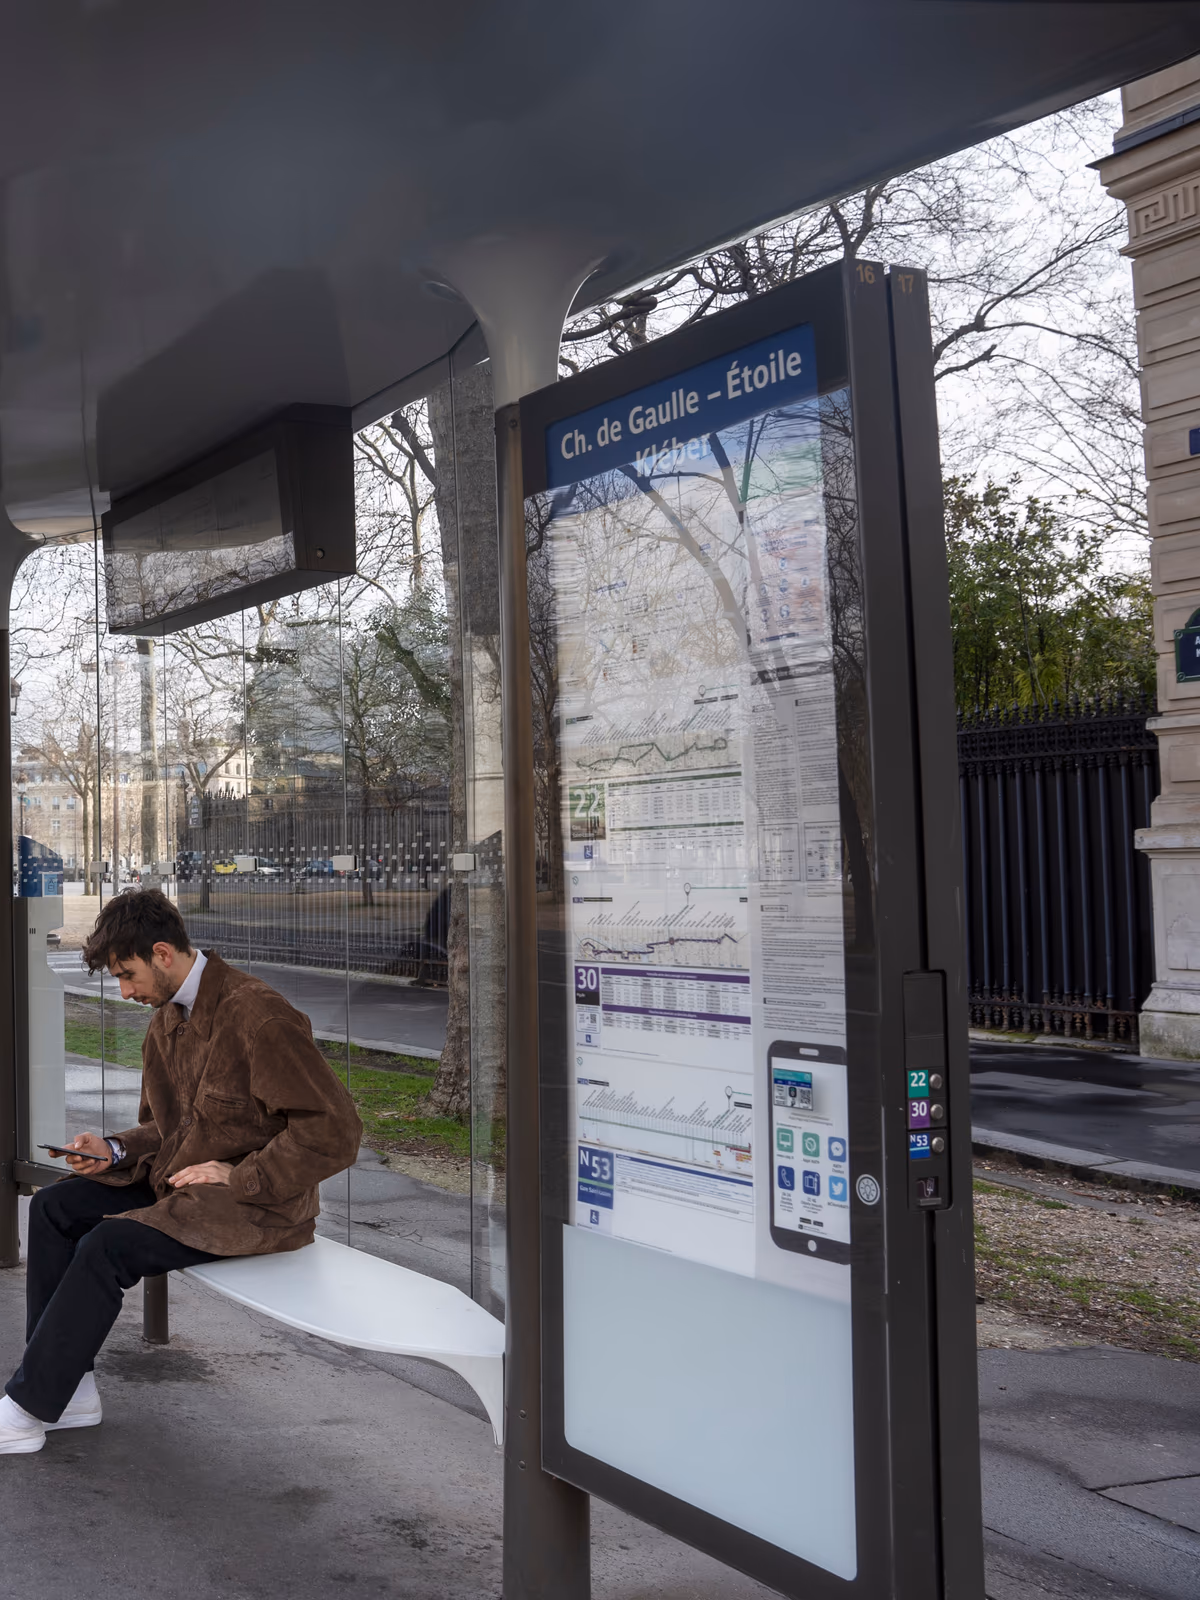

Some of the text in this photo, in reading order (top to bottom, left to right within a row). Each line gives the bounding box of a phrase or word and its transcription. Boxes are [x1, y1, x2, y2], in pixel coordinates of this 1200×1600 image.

[856, 264, 875, 284] 16
[897, 274, 914, 295] 17
[561, 429, 592, 459] Ch.
[597, 418, 622, 447] de
[629, 388, 699, 434] Gaulle
[726, 349, 802, 399] Étoile
[635, 432, 711, 477] Kléber
[574, 788, 600, 818] 22
[577, 968, 597, 990] 30
[910, 1072, 926, 1087] 22
[911, 1102, 927, 1117] 30
